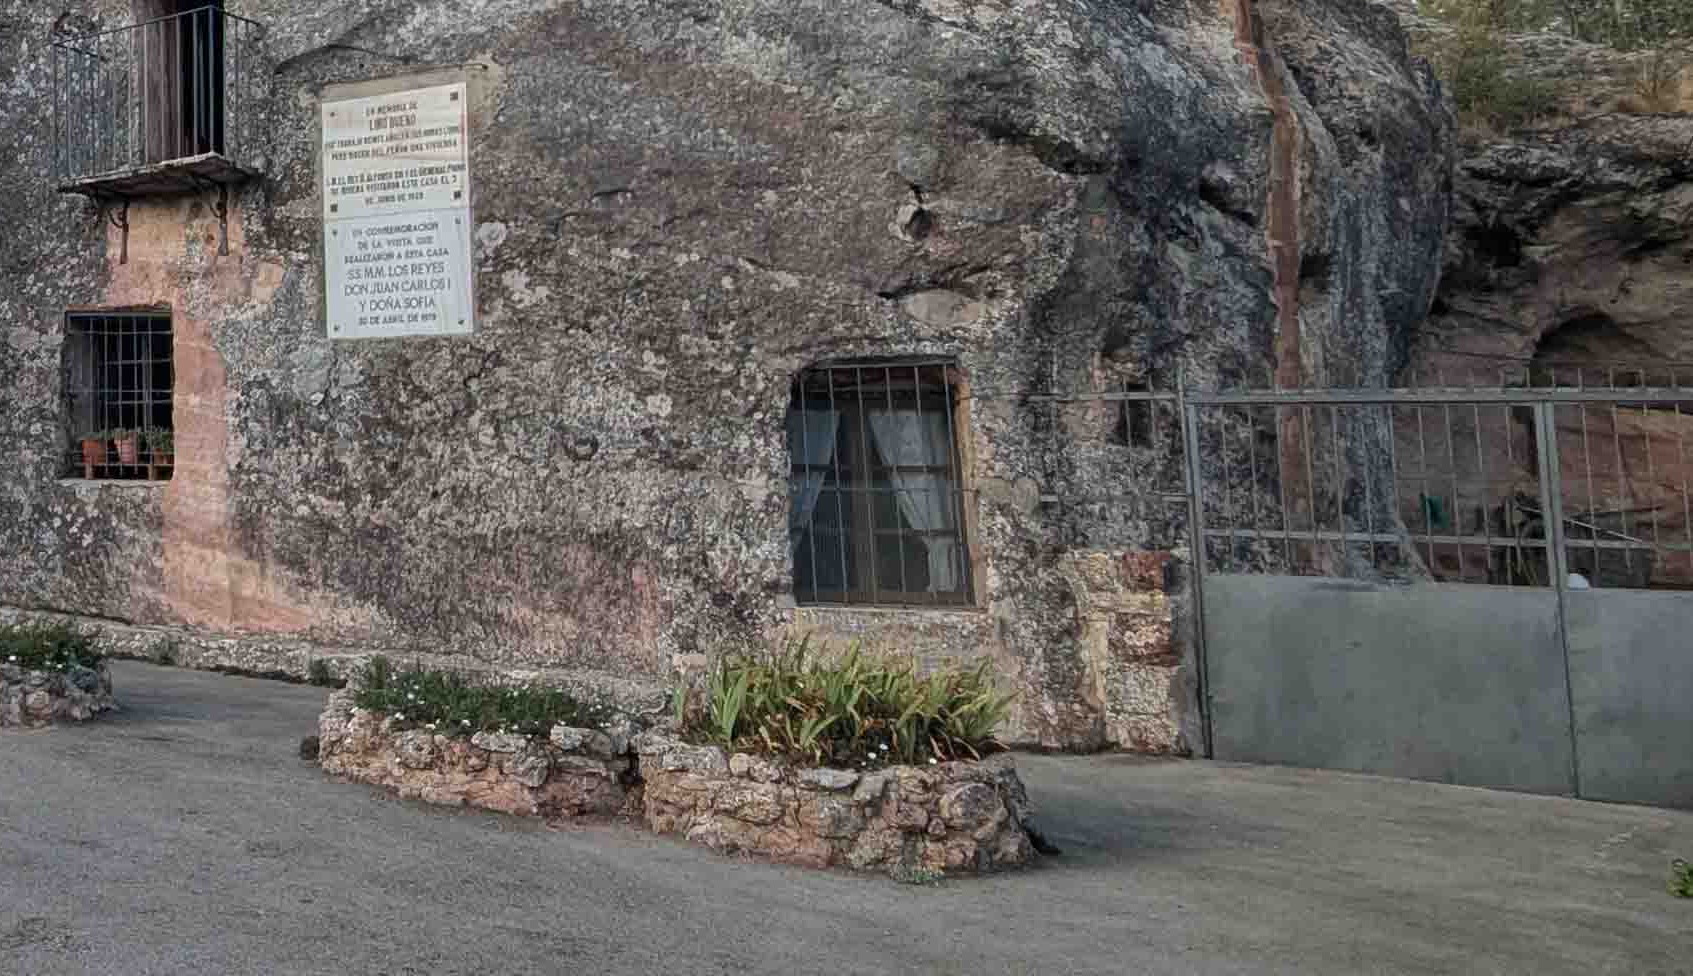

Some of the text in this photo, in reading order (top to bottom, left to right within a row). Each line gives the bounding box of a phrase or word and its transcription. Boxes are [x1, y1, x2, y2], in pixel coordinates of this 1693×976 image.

[357, 241, 368, 251] DE
[372, 239, 382, 249] LA
[387, 237, 412, 248] VISITA
[396, 251, 403, 260] A
[405, 249, 424, 259] ESTA
[426, 247, 450, 258] CASA
[388, 264, 409, 277] LOS
[411, 262, 445, 276] REYES
[344, 284, 368, 297] DON
[369, 280, 399, 295] JUAN
[401, 278, 445, 293] CARLOS
[359, 299, 366, 313] Y
[369, 295, 402, 312] DOÑA
[369, 315, 380, 325] DE
[407, 312, 419, 323] DE
